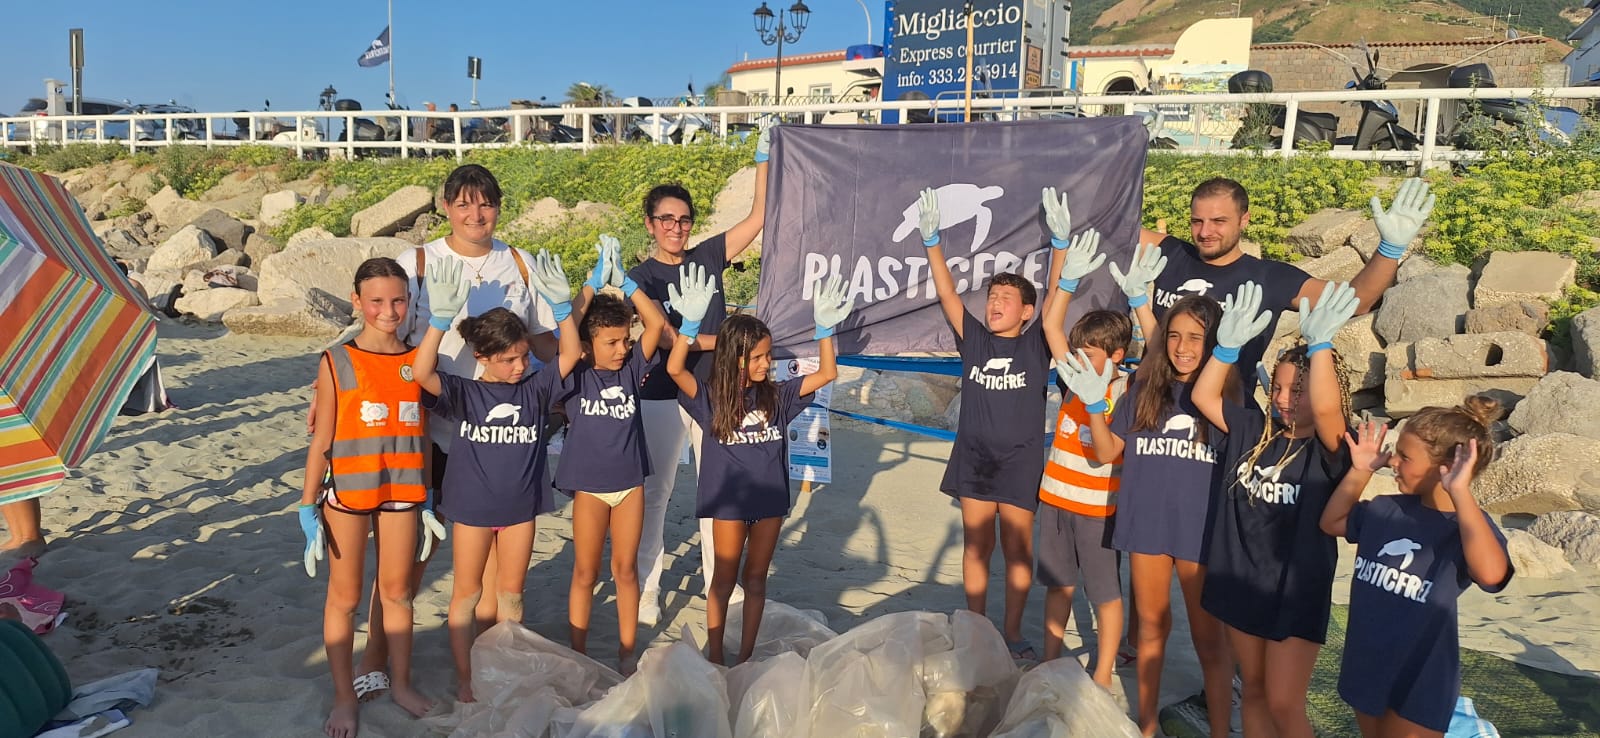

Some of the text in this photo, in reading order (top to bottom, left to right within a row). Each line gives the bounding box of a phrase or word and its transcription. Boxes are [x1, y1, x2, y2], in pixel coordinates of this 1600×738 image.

[897, 2, 1021, 40] Migliaccio
[900, 46, 953, 67] Express
[897, 70, 925, 88] info:
[928, 62, 1018, 85] 333.235914
